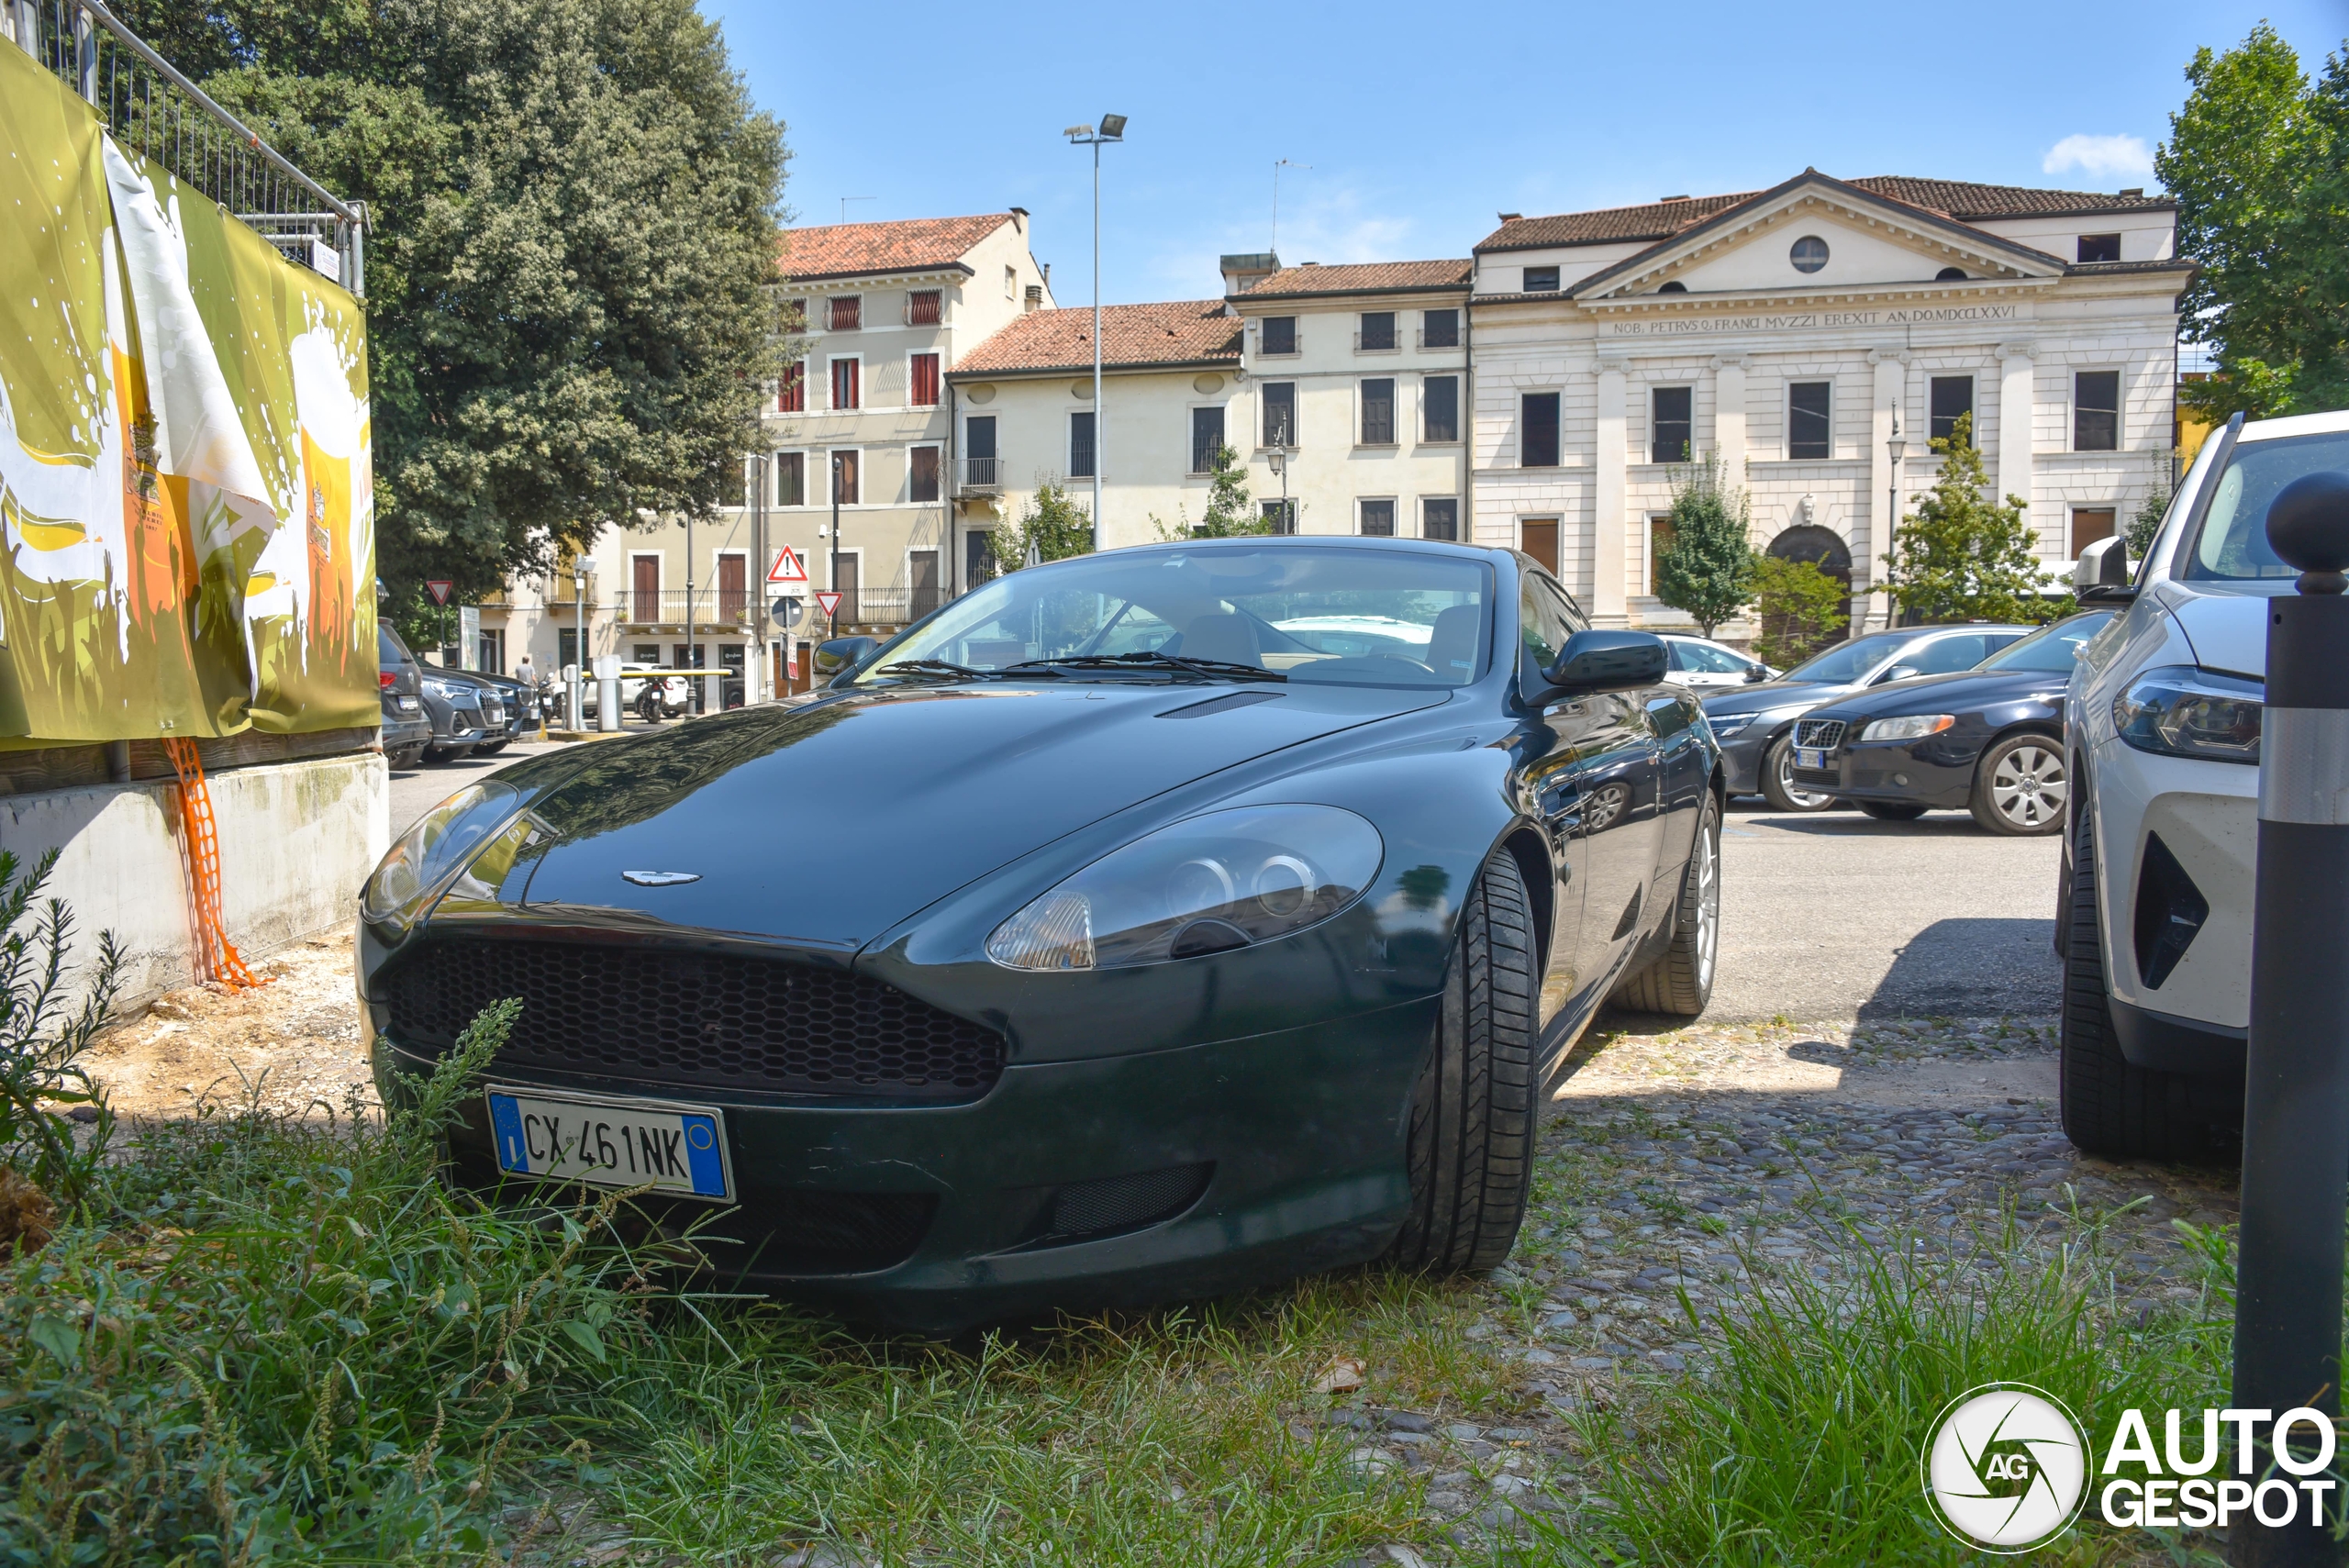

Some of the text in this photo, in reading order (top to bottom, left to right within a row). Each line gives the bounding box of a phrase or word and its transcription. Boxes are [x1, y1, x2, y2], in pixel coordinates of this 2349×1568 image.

[1651, 319, 1698, 332] PETRVS
[1765, 315, 1816, 328] MVZZI
[1825, 312, 1880, 325] EREXIT
